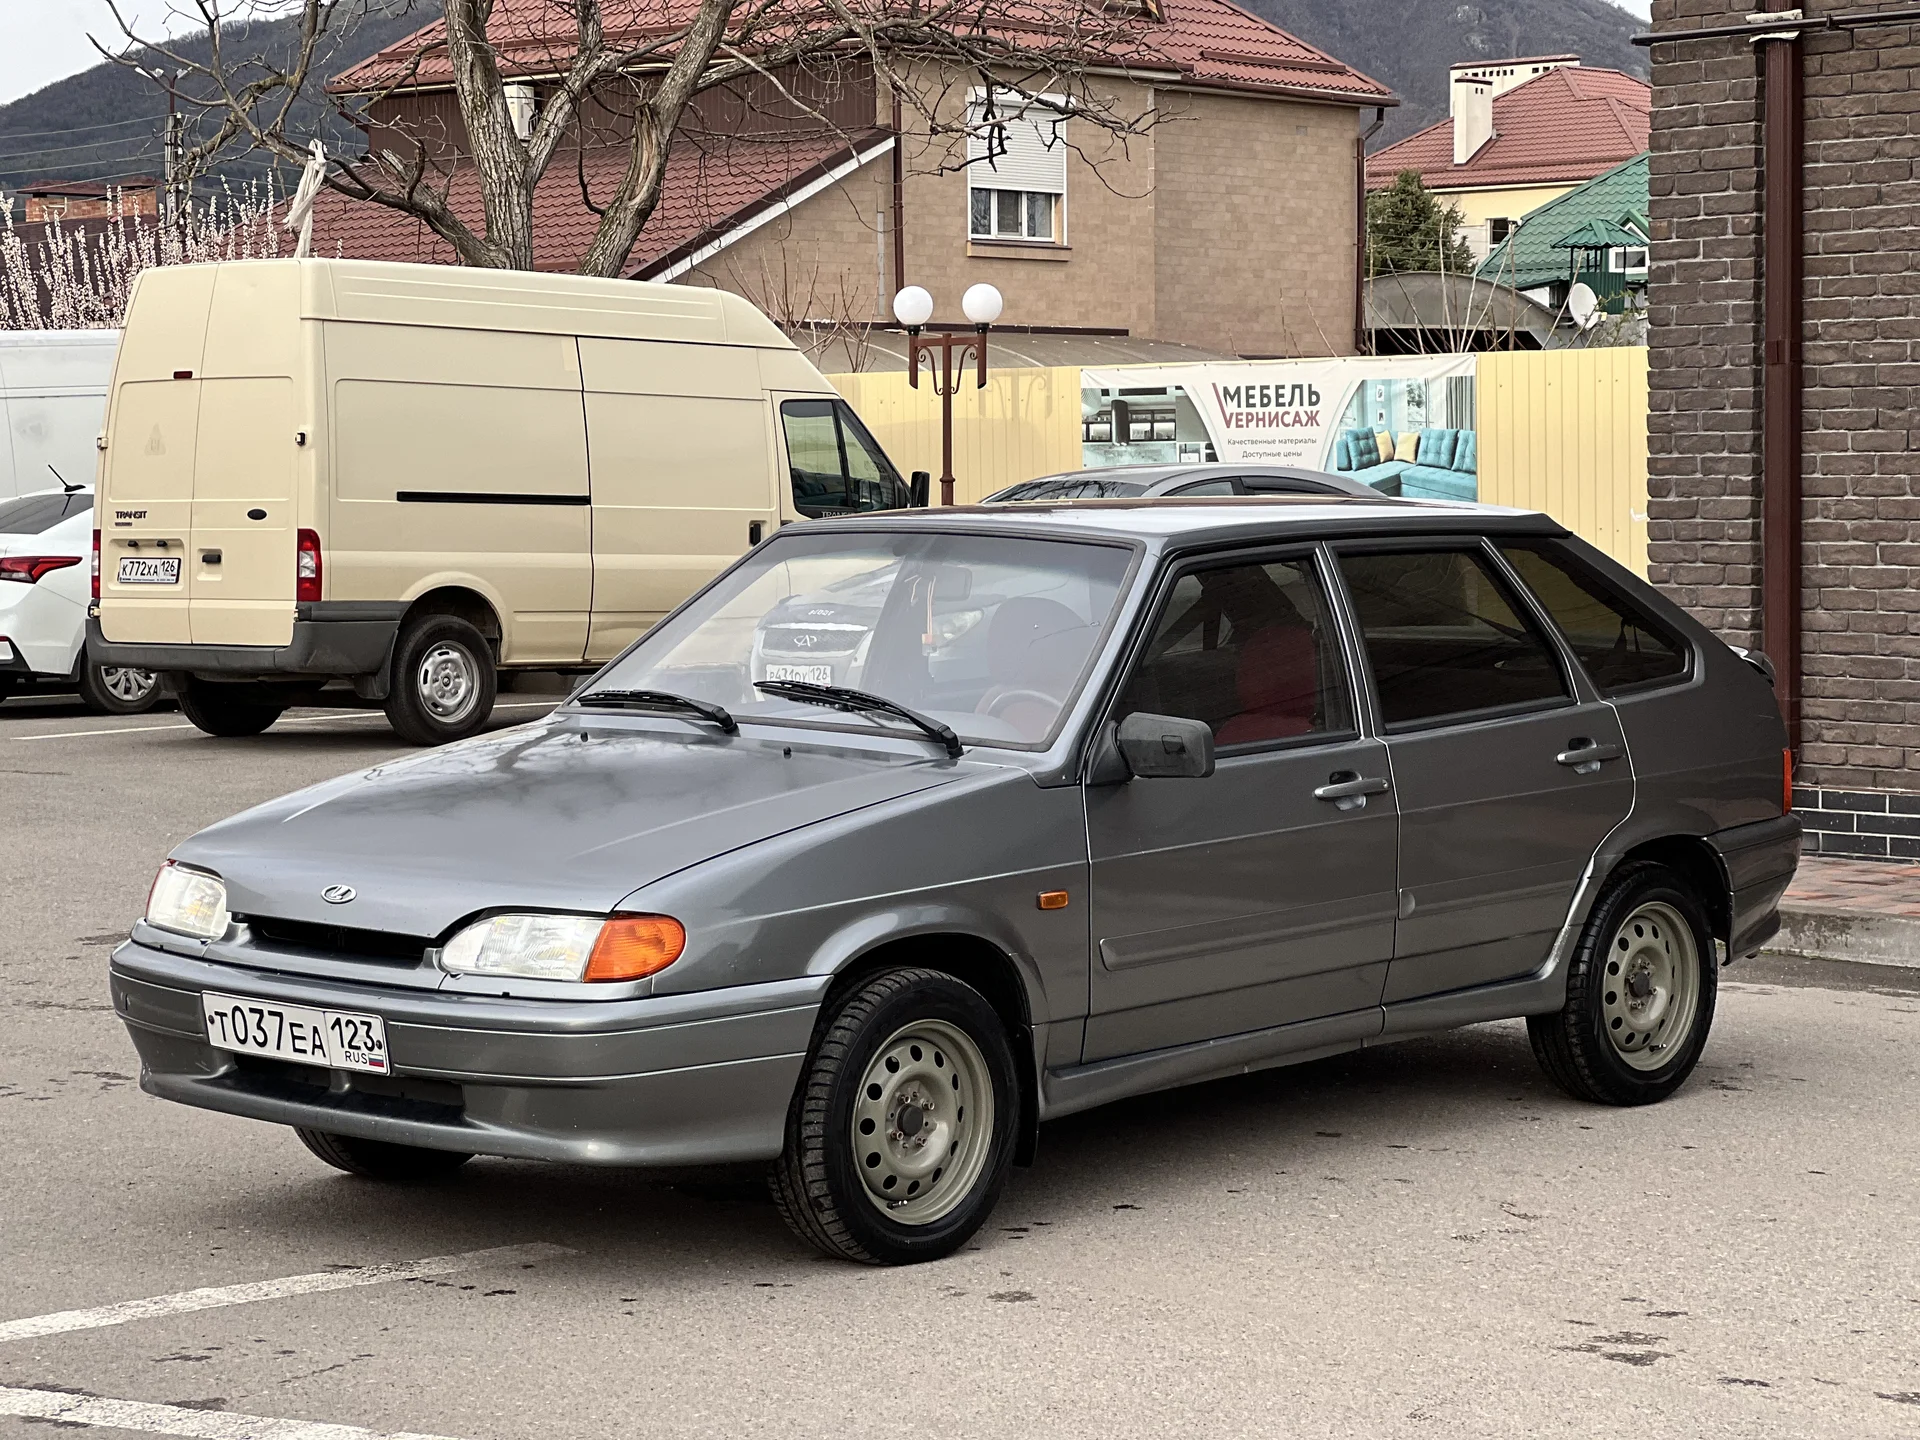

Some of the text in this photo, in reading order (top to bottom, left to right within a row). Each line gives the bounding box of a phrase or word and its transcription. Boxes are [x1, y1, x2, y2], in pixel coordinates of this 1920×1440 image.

[1222, 383, 1321, 409] МЕБЕЛЬ
[1227, 437, 1317, 446] Качественные материалы
[1242, 450, 1303, 459] Доступные цены
[115, 510, 148, 519] TRANSIT
[161, 560, 176, 574] 126
[810, 667, 828, 681] 126
[214, 1005, 375, 1058] Т037ЕА 123
[345, 1051, 368, 1065] RUS
